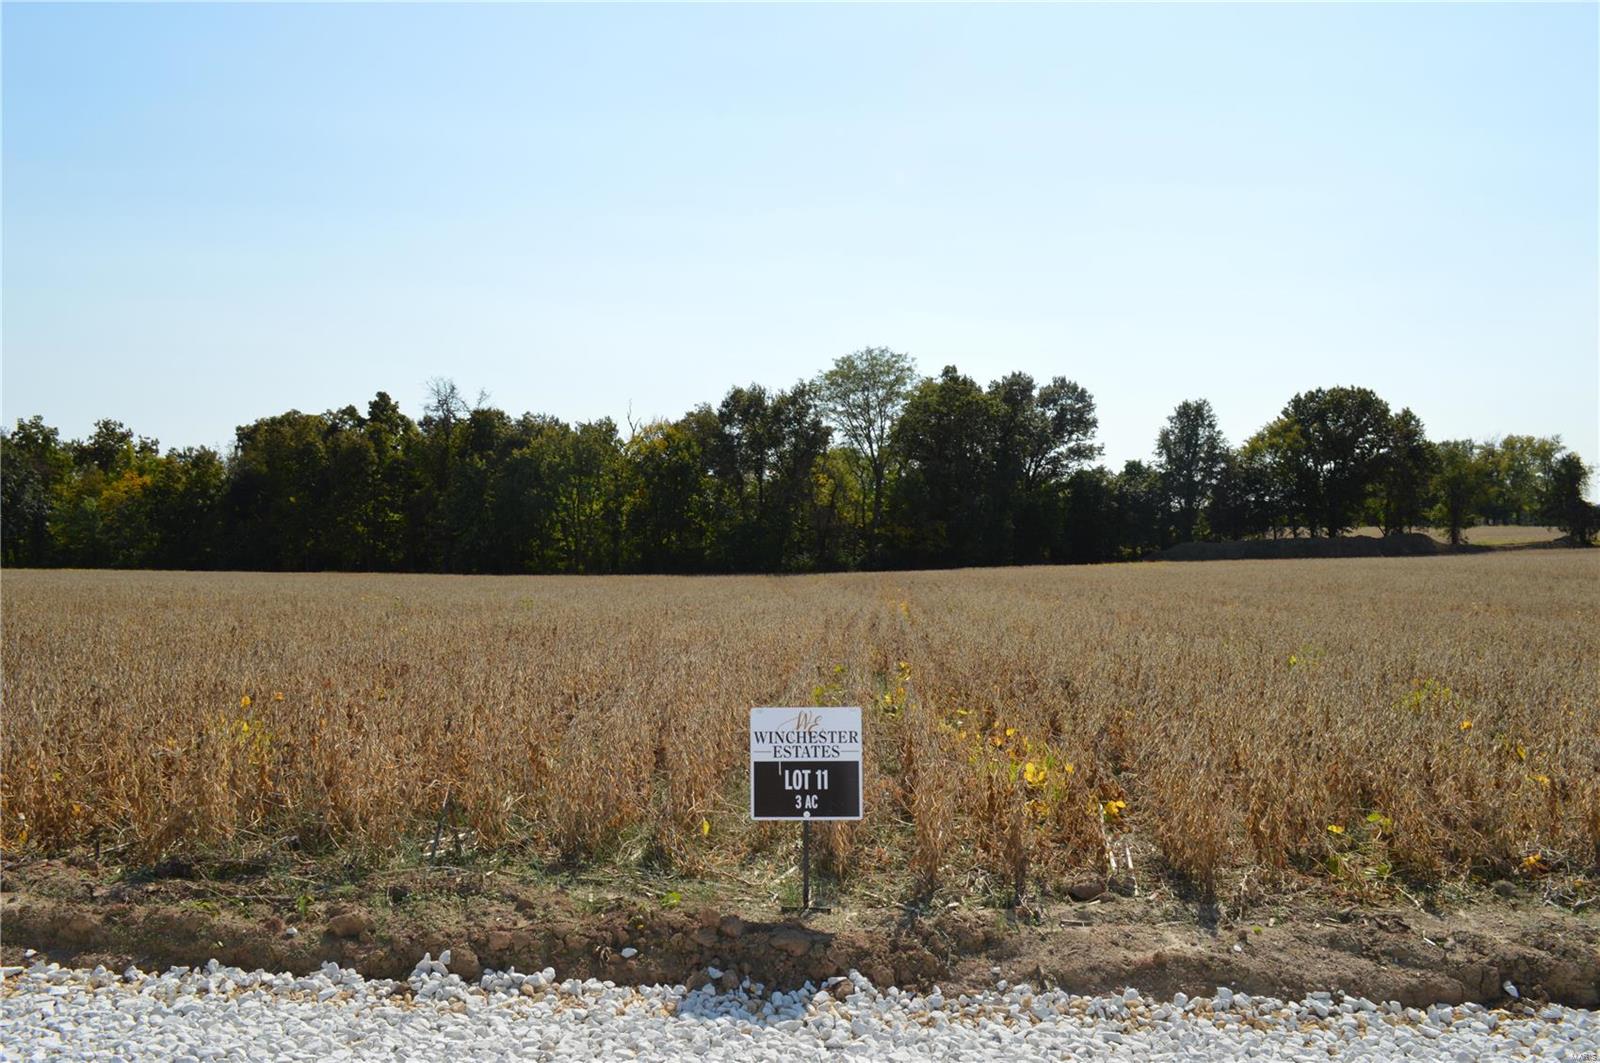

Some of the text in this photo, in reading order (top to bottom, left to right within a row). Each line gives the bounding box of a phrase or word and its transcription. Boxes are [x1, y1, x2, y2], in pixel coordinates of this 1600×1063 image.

[754, 730, 858, 744] WINCHESTER
[773, 745, 840, 758] ESTATES
[784, 769, 829, 790] LOT 11
[795, 795, 819, 809] 3 AC
